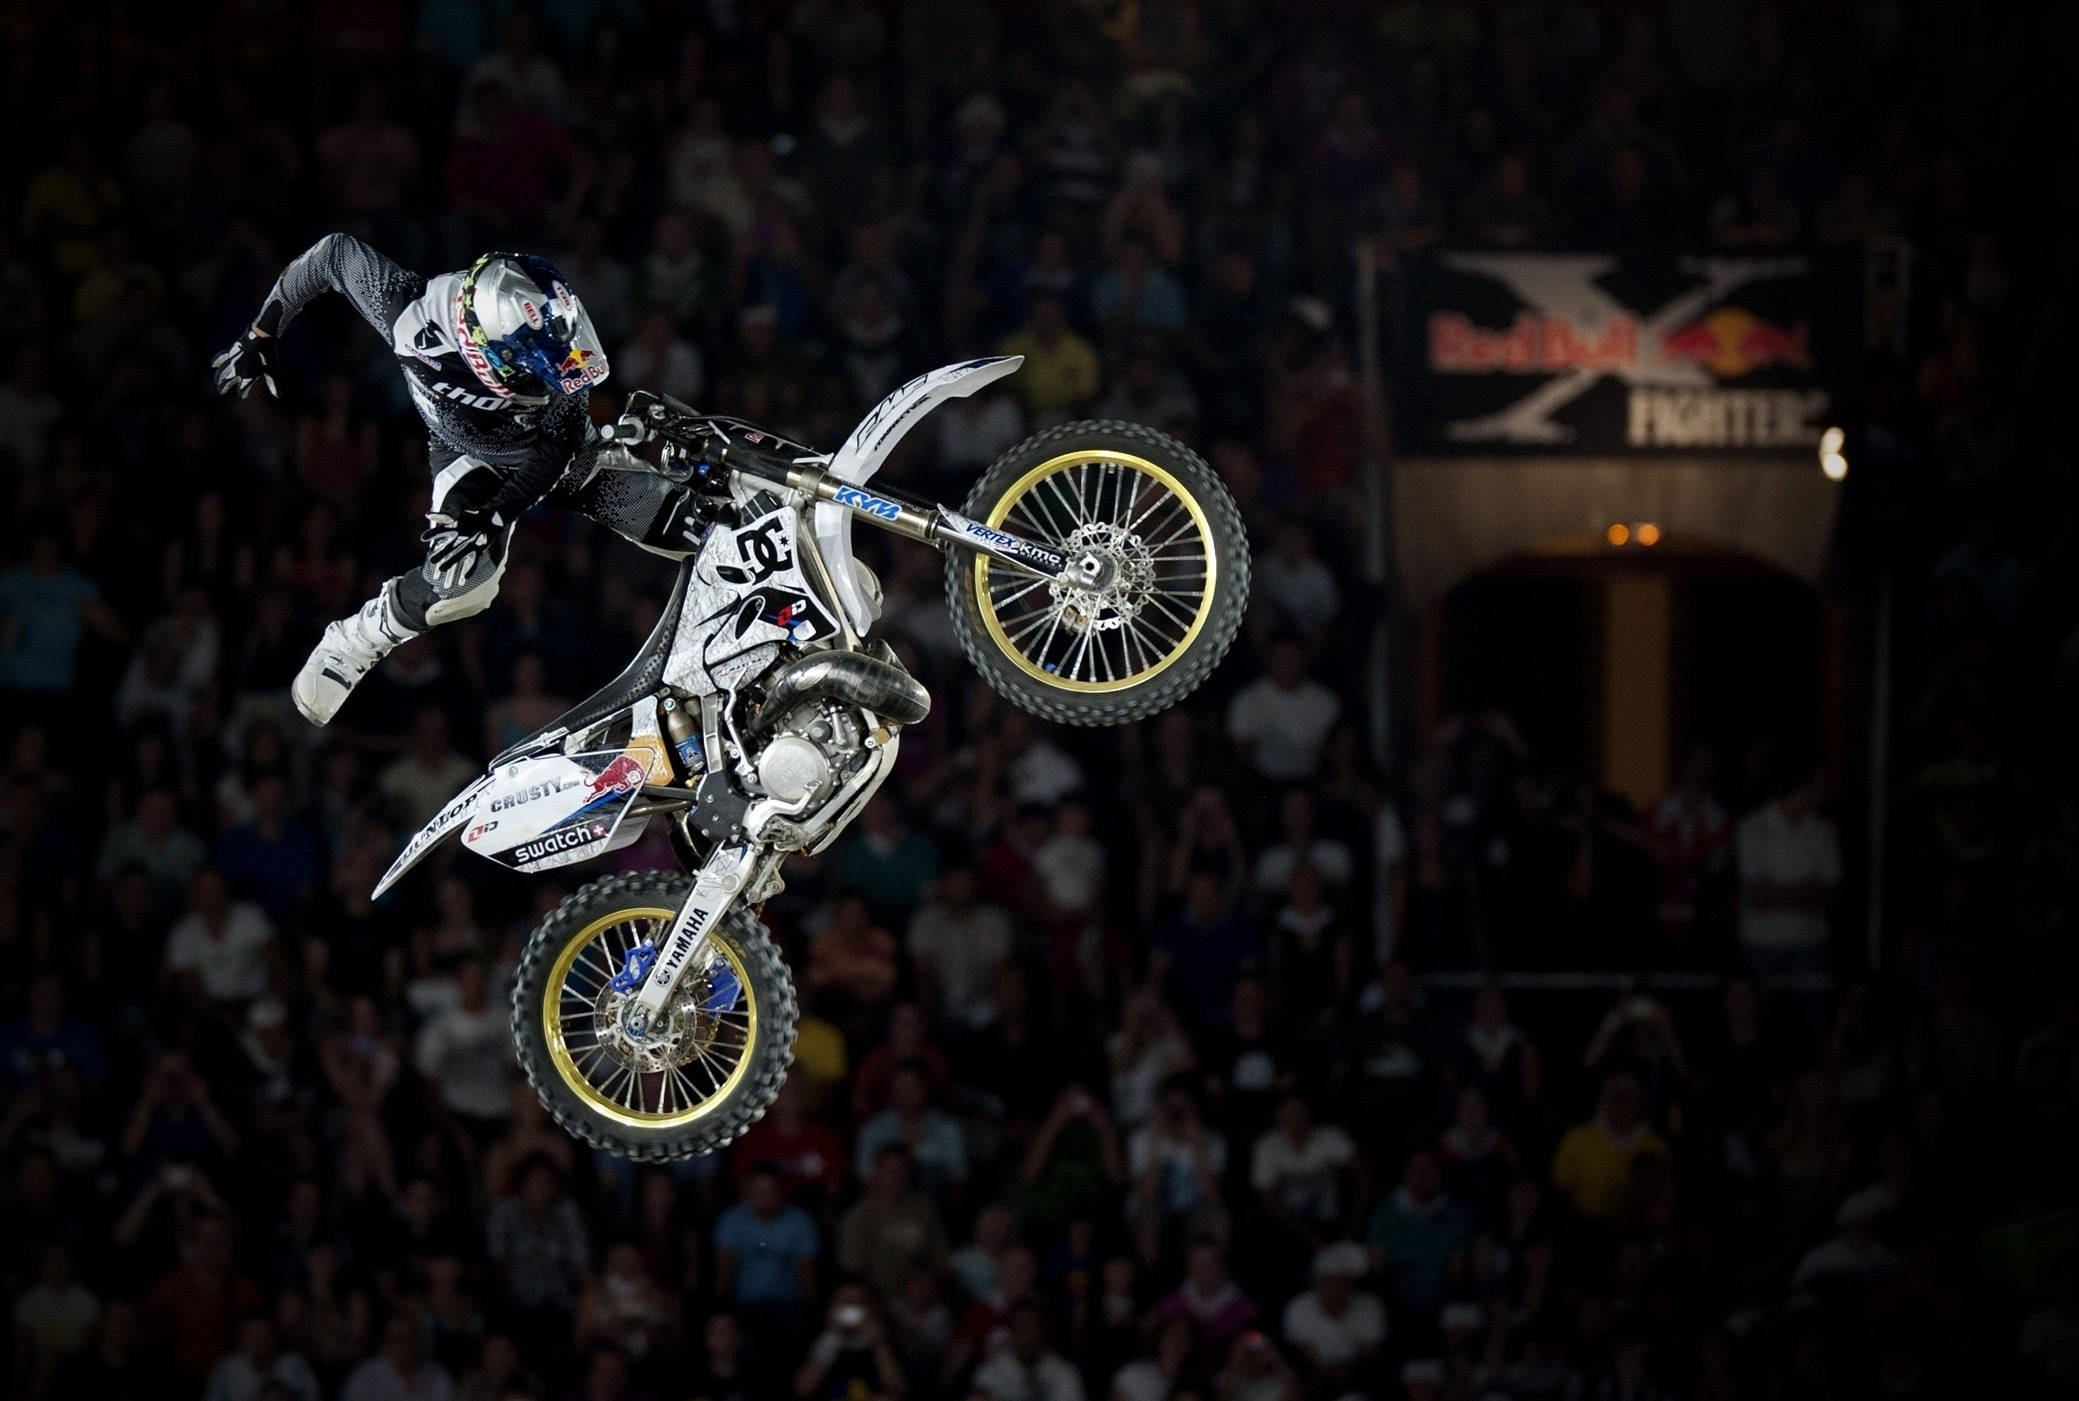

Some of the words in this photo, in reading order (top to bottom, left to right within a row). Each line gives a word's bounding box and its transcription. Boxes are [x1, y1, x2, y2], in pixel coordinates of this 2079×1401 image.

[523, 301, 539, 324] BELL
[1430, 310, 1533, 373] Red
[1541, 312, 1639, 373] Bull
[563, 368, 589, 392] Red
[834, 488, 900, 519] KYB
[966, 523, 1017, 548] VERTEX
[401, 793, 476, 861] DUNLOP
[515, 827, 592, 862] swatch
[666, 907, 709, 968] YAMAHA
